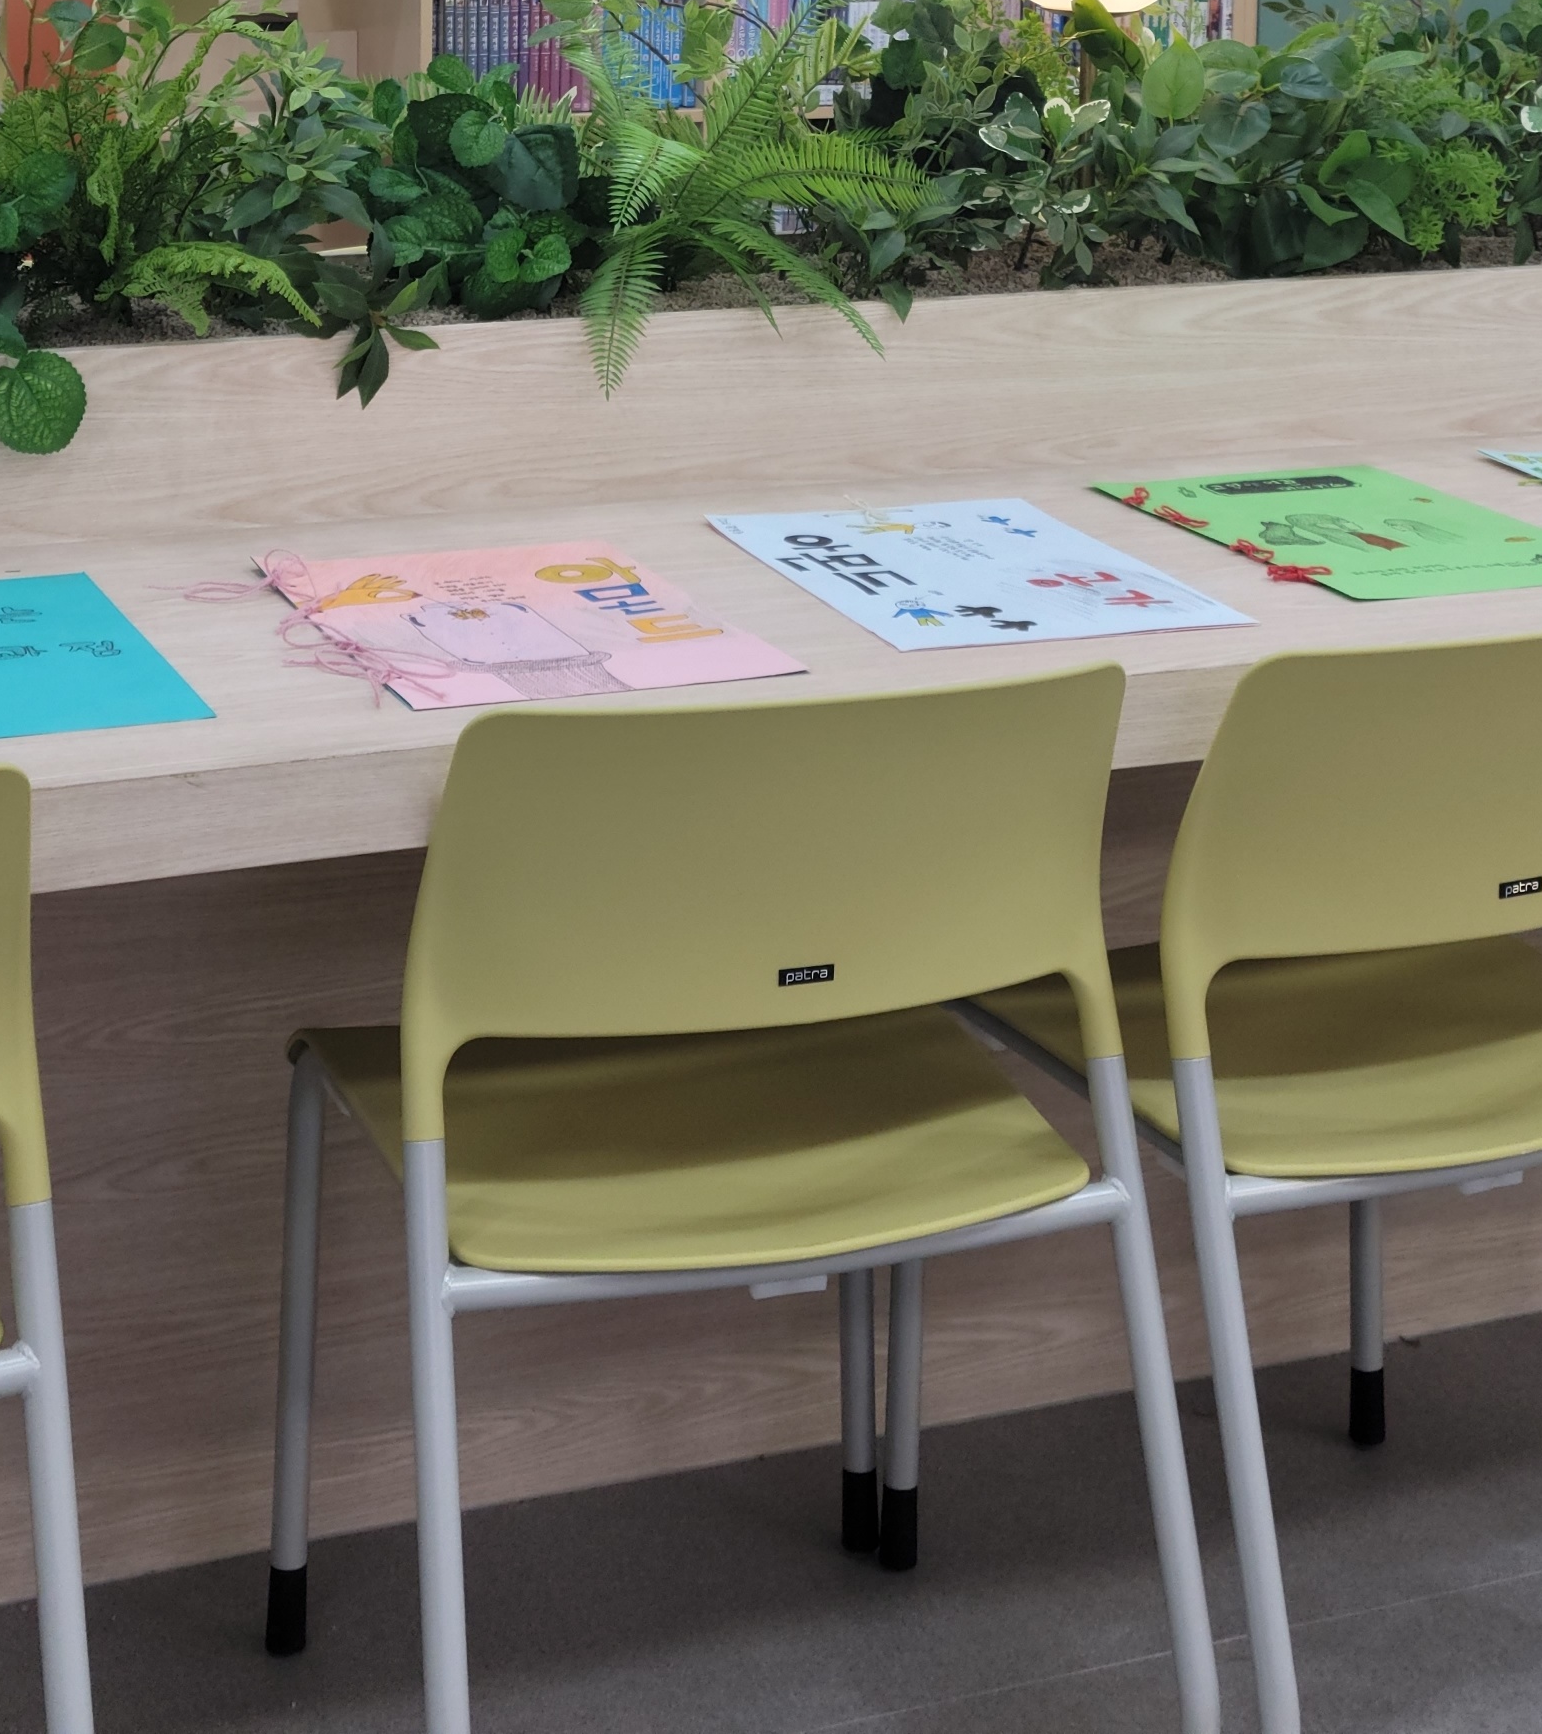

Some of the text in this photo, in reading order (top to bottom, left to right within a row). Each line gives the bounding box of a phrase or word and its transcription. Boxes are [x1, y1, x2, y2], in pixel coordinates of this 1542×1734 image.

[775, 533, 918, 596] 아몬드
[1504, 879, 1540, 898] patra
[785, 966, 830, 985] patra
